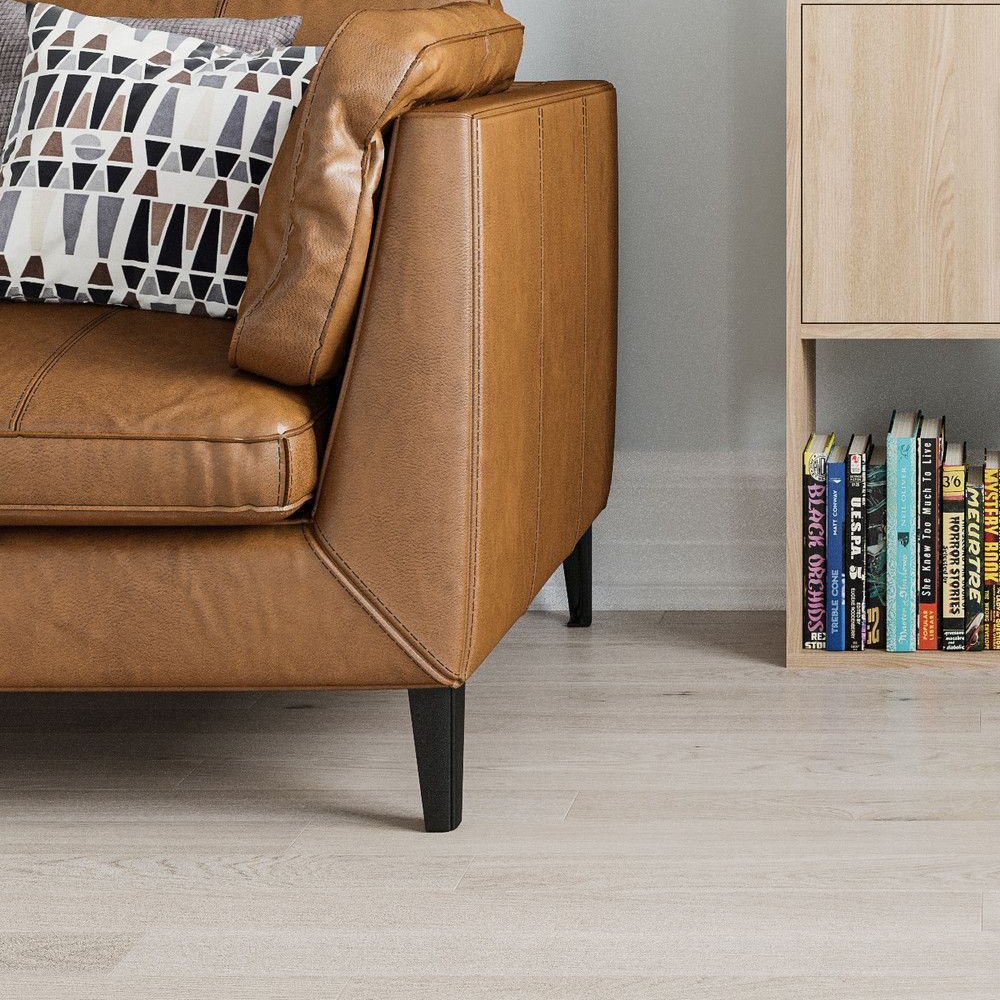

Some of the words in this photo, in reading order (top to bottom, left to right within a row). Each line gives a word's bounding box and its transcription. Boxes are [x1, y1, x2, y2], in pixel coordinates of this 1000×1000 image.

[922, 442, 932, 464] Live
[922, 471, 932, 482] To
[808, 483, 826, 548] BLACK
[922, 488, 932, 514] Much
[984, 468, 999, 534] MYSTERY
[922, 522, 932, 539] Too
[949, 517, 960, 566] HORROR
[967, 487, 982, 604] MEURTRE
[922, 545, 932, 571] Knew
[984, 544, 999, 583] BOOK
[808, 552, 826, 632] ORCHIDS
[922, 578, 932, 596] She
[949, 569, 960, 615] STORIES
